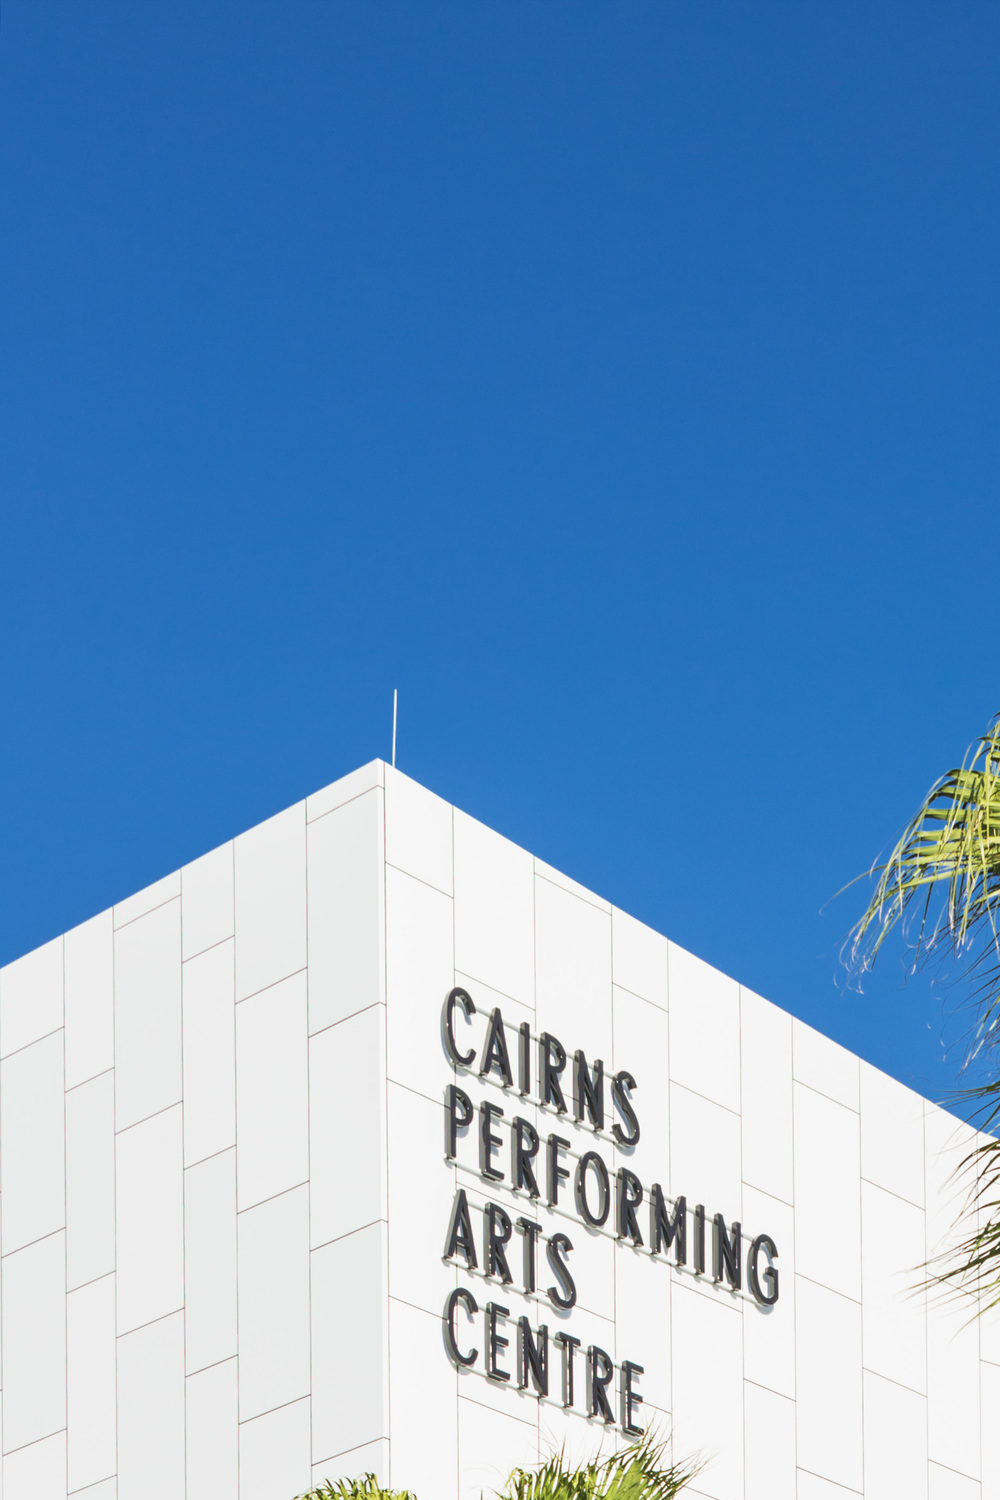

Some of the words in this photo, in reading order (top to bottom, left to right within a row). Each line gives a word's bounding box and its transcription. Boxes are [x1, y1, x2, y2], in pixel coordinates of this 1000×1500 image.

[442, 987, 641, 1147] CAIRNS
[442, 1188, 577, 1310] ARTS
[444, 1083, 779, 1306] PERFORMING
[442, 1287, 645, 1436] CENTRE
